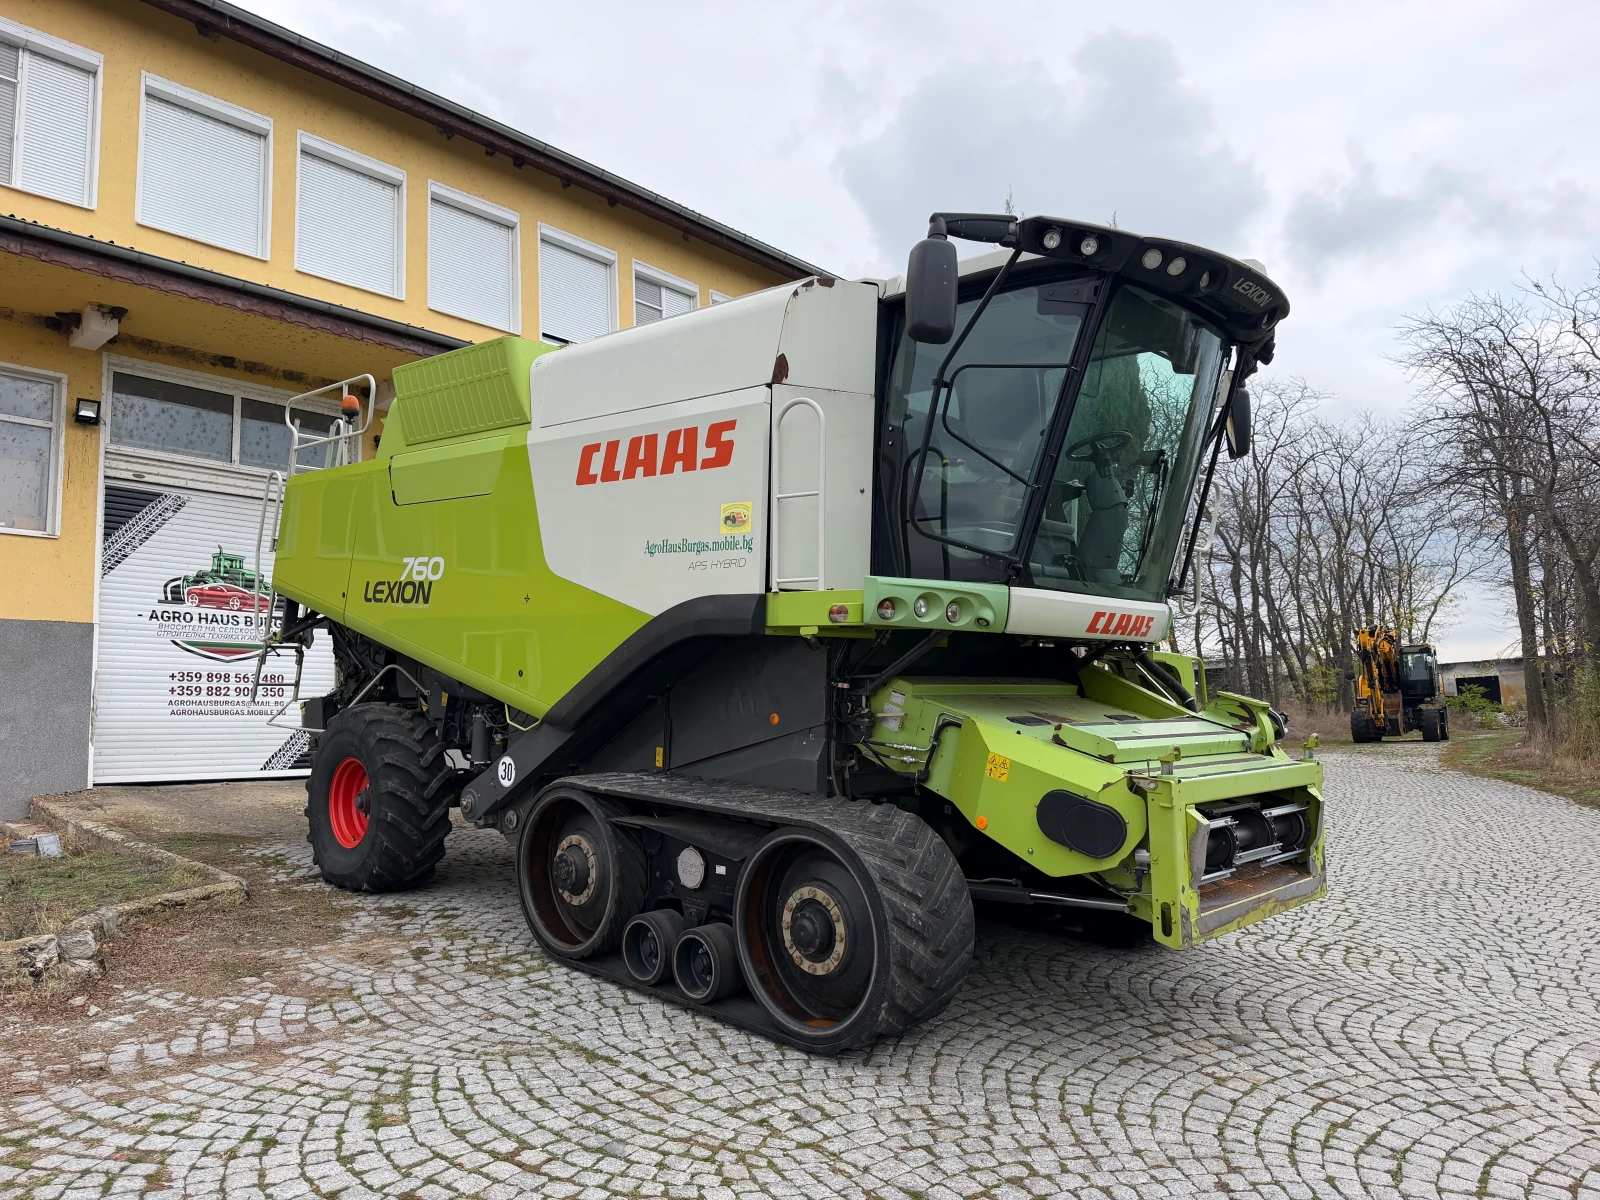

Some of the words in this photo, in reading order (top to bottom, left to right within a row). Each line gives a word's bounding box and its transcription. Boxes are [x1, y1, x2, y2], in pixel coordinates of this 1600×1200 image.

[1232, 277, 1273, 307] LEXION
[575, 419, 738, 486] CLAAS
[644, 534, 754, 557] AgroHausBurgas.mobile.bg
[400, 556, 445, 581] 760
[687, 560, 708, 571] APS
[710, 557, 747, 569] HYBRID
[363, 580, 433, 604] LEXION
[148, 609, 194, 623] AGRO
[198, 612, 240, 626] HAUS
[158, 622, 203, 632] ВНОСИТЕЛ
[1085, 611, 1155, 637] CLAAS
[168, 671, 203, 683] +359
[206, 672, 231, 684] 898
[261, 674, 285, 684] 480
[168, 685, 203, 697] +359
[206, 686, 231, 697] 882
[234, 686, 256, 698] 90
[261, 687, 285, 698] 350
[169, 709, 287, 717] AGROHAUSBURGAS.MOBILEG
[501, 761, 513, 781] 30
